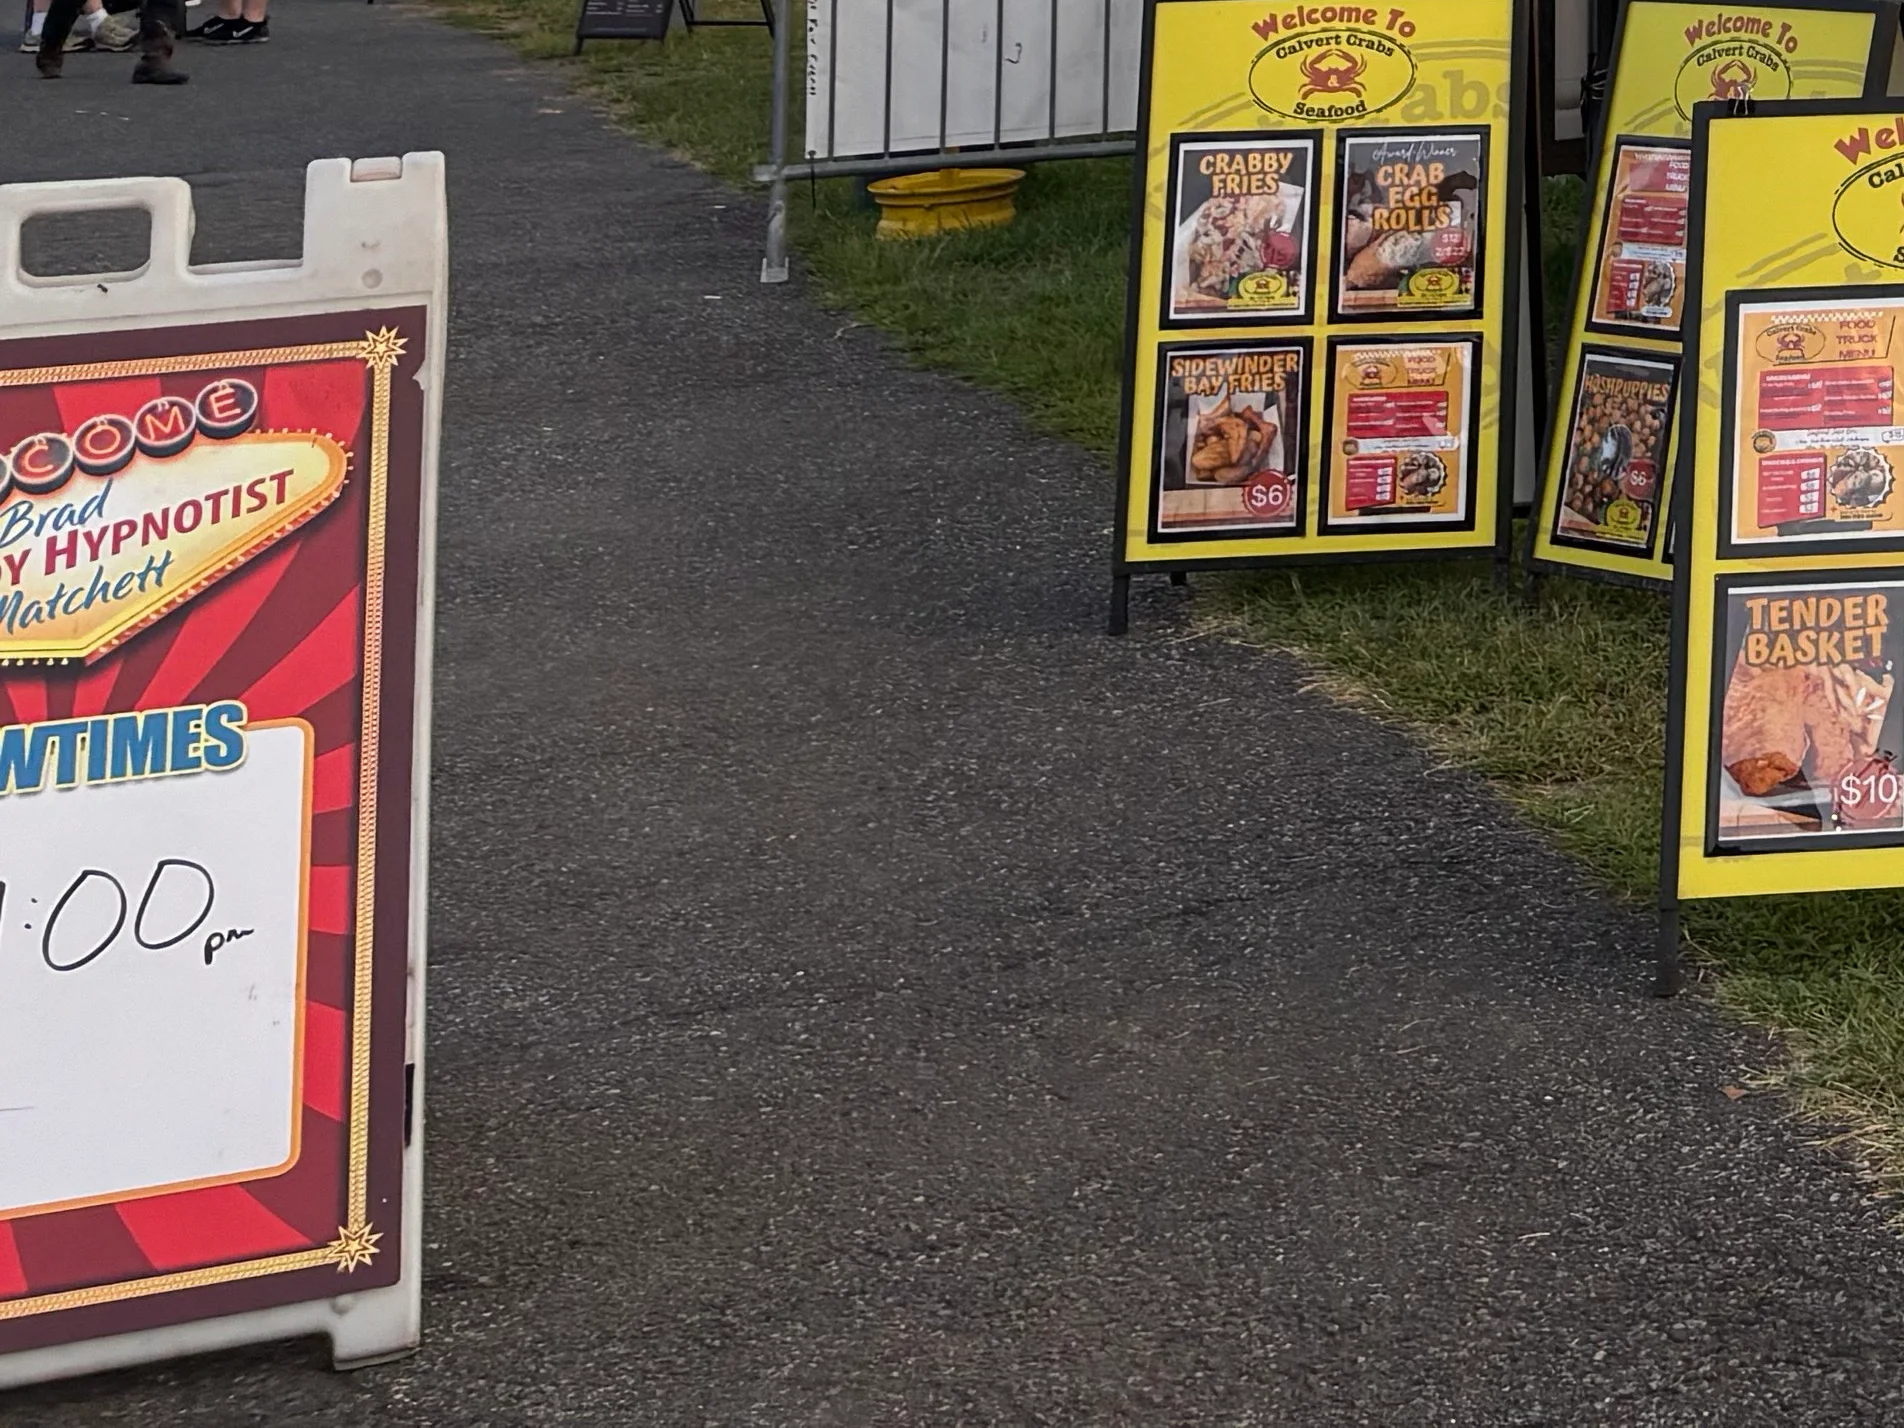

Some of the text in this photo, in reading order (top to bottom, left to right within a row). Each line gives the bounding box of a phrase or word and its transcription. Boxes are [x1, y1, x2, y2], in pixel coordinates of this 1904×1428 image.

[1251, 5, 1417, 42] Welcome To
[1684, 13, 1799, 54] Welcome To
[1275, 32, 1395, 61] Calvert Crabs
[1696, 44, 1780, 72] Calvert Crabs
[1293, 99, 1368, 119] Seafood
[1199, 151, 1294, 175] CRABBY
[1374, 162, 1446, 187] CRAB
[1211, 173, 1280, 196] FRIES
[1388, 186, 1440, 209] EGG
[1371, 206, 1452, 231] ROLLS
[1839, 319, 1877, 330] FOOD
[1835, 333, 1879, 346] TRUCK
[1171, 352, 1301, 377] SIDEWINDER
[1183, 371, 1288, 395] BAY FRIES
[1250, 482, 1285, 507] $6
[0, 477, 113, 546] Brad
[44, 468, 294, 577] HYPNOTIST
[1745, 592, 1890, 631] TENDER
[1745, 624, 1889, 668] BASKET
[1840, 774, 1899, 806] $10
